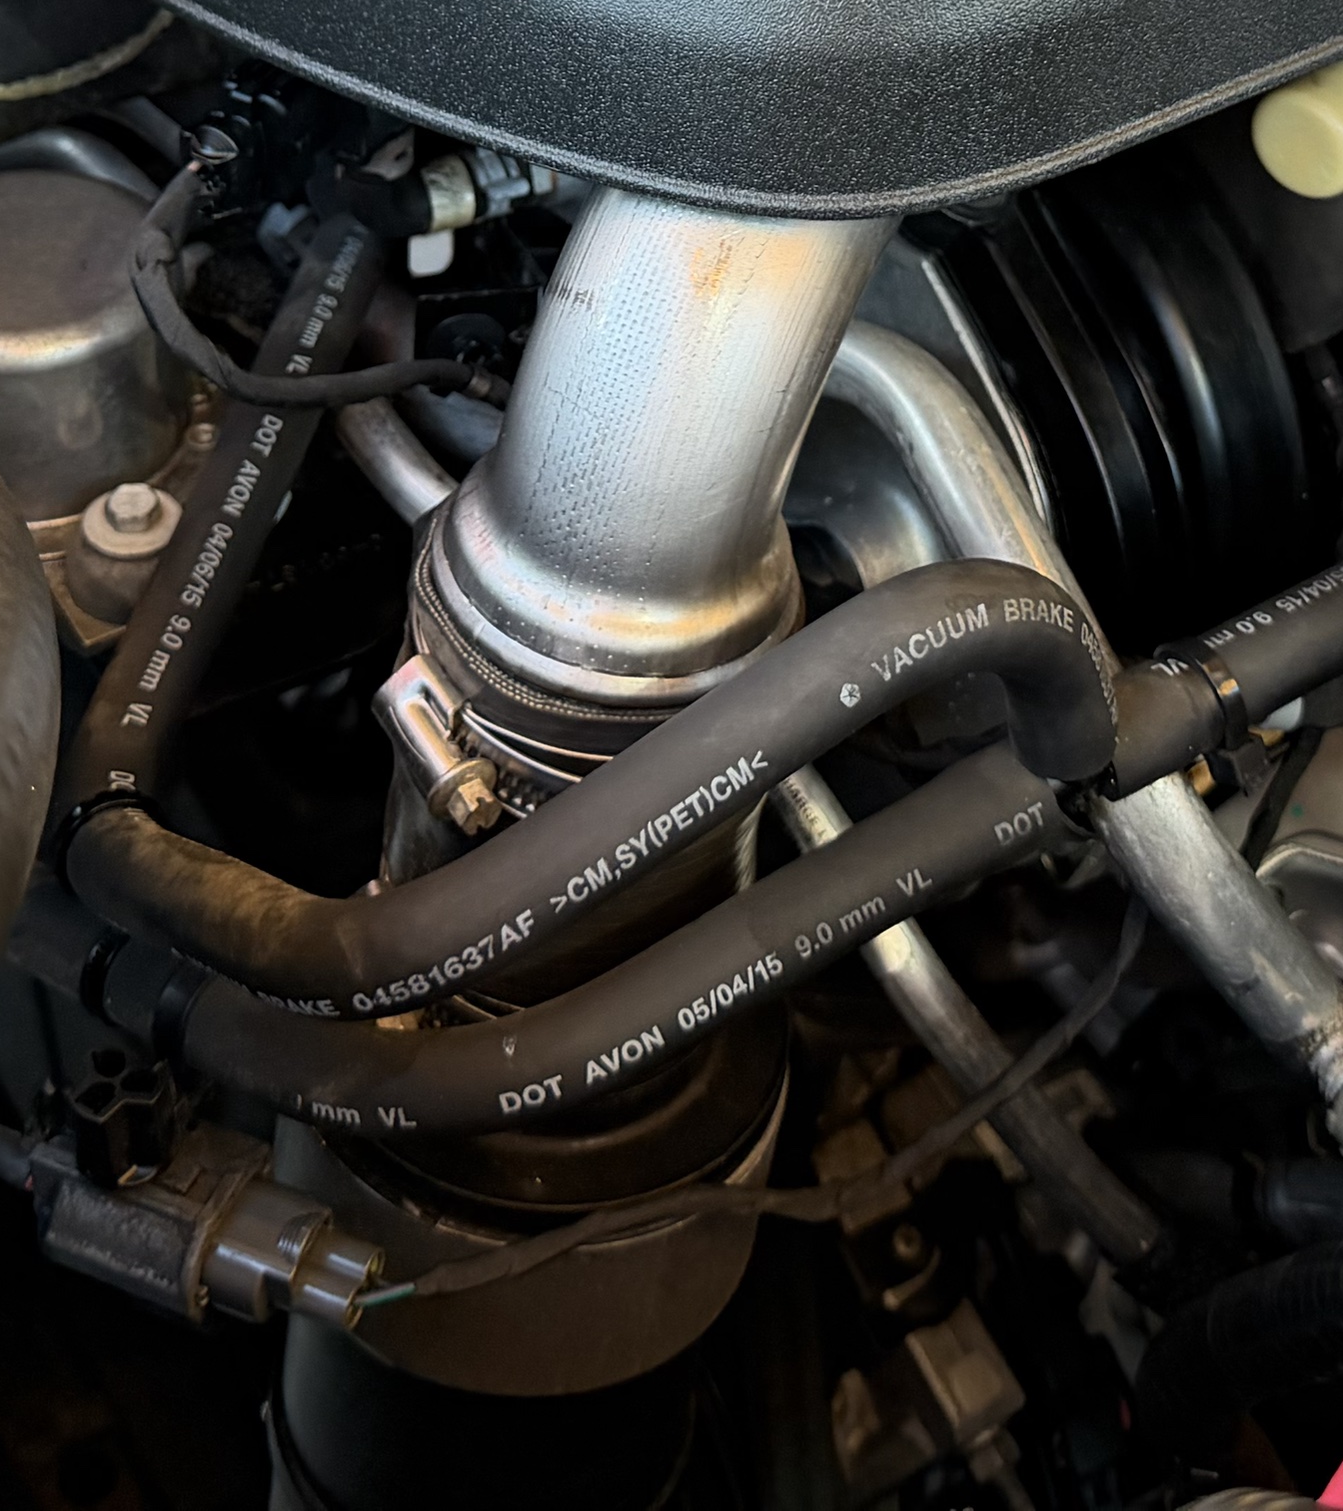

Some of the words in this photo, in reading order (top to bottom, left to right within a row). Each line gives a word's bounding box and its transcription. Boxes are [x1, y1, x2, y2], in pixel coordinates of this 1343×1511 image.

[299, 316, 325, 349] mm
[250, 413, 284, 458] DOT
[221, 459, 261, 518] AVON
[180, 522, 233, 609] 04/06/15
[161, 614, 192, 651] 9.0
[871, 602, 990, 682] VACUUM
[1002, 597, 1074, 633] BRAKE
[1235, 610, 1274, 635] 9.0
[138, 650, 171, 692] mm
[120, 702, 153, 727] VL
[782, 776, 820, 826] HARGE
[993, 801, 1046, 847] DOT
[352, 908, 537, 1013] 04581637AF
[550, 750, 769, 915] >CM,SY(PET)CM<
[498, 1074, 565, 1115] DOT
[584, 1024, 666, 1085] AVON
[677, 952, 785, 1032] 05/04/15
[794, 920, 835, 960] 9.0
[838, 894, 888, 935] mm
[896, 867, 933, 900] VL
[312, 1100, 362, 1127] mm
[377, 1105, 418, 1129] VL
